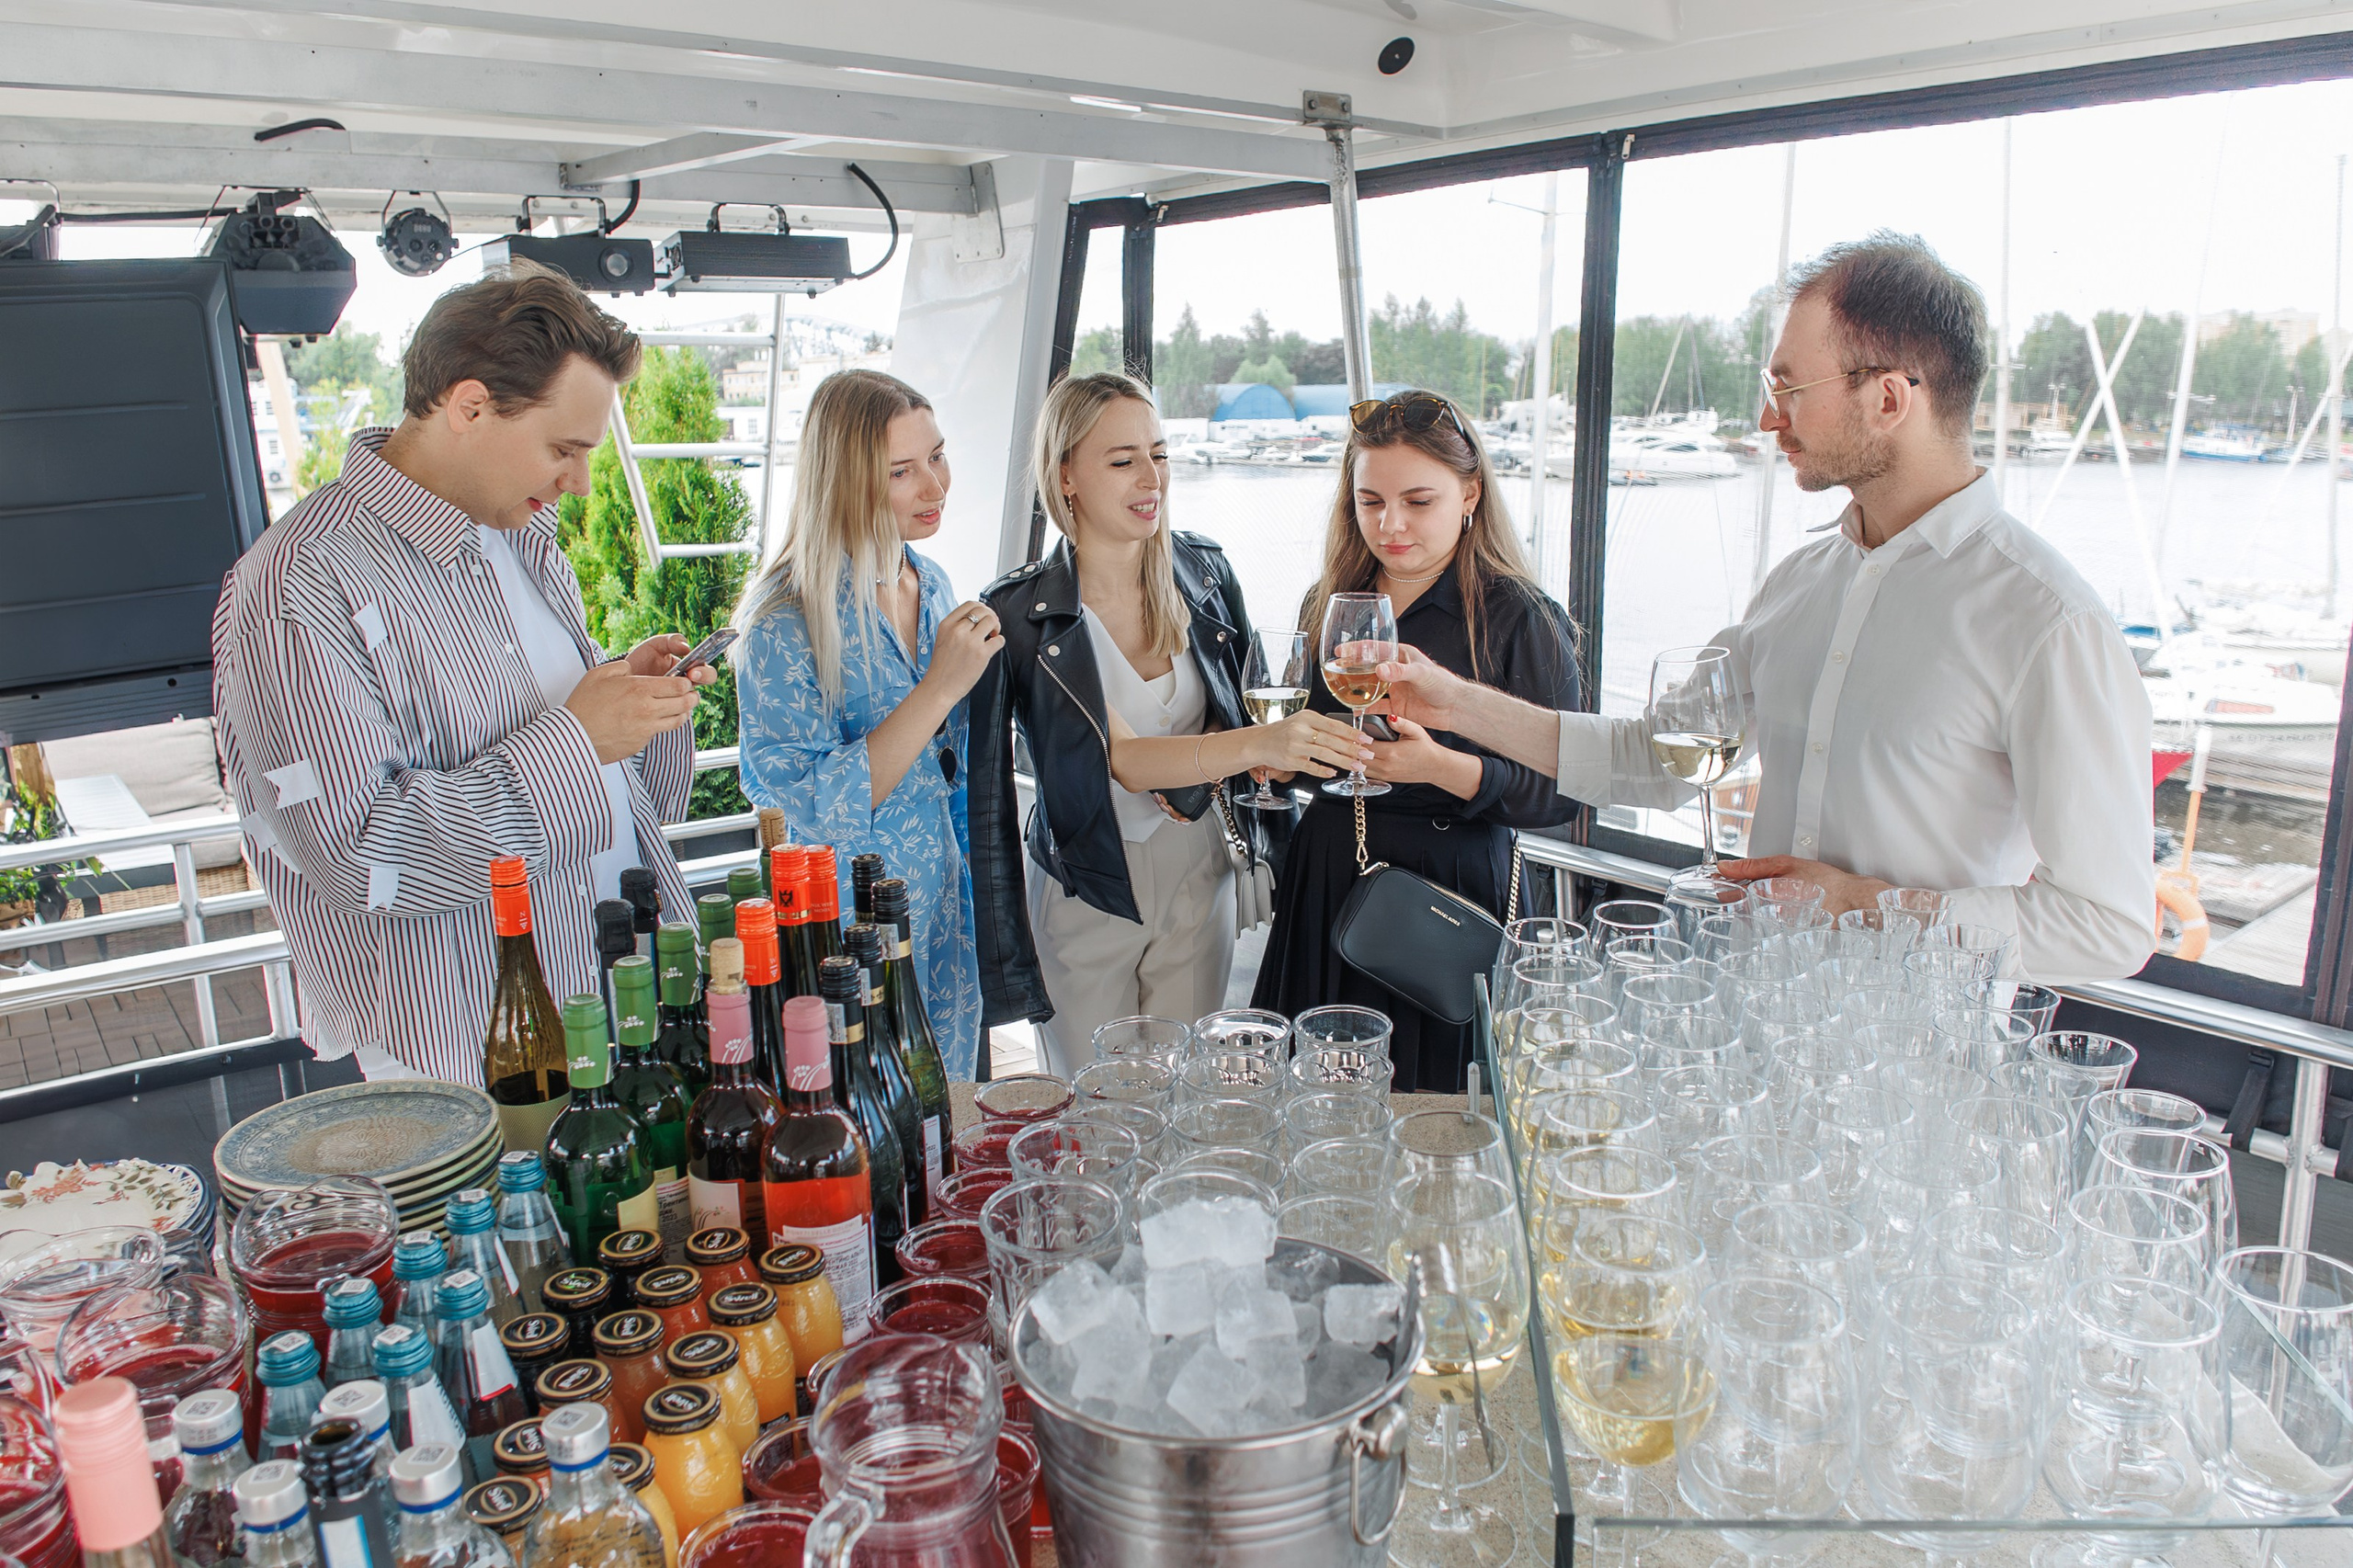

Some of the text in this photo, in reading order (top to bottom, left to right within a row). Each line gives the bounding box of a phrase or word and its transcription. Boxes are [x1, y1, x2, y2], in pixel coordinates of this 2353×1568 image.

[622, 1234, 640, 1251] Swell
[708, 1233, 725, 1248] Swell
[778, 1250, 806, 1267] Swell
[560, 1278, 591, 1289] Swell
[653, 1274, 686, 1289] Swell
[724, 1291, 758, 1303] Swell
[525, 1319, 540, 1340] Swell
[620, 1316, 636, 1337] Swell
[684, 1339, 718, 1358] Swell
[559, 1366, 590, 1389] Swell
[665, 1393, 698, 1412] Swell
[610, 1459, 632, 1472] well
[487, 1486, 513, 1512] Swell
